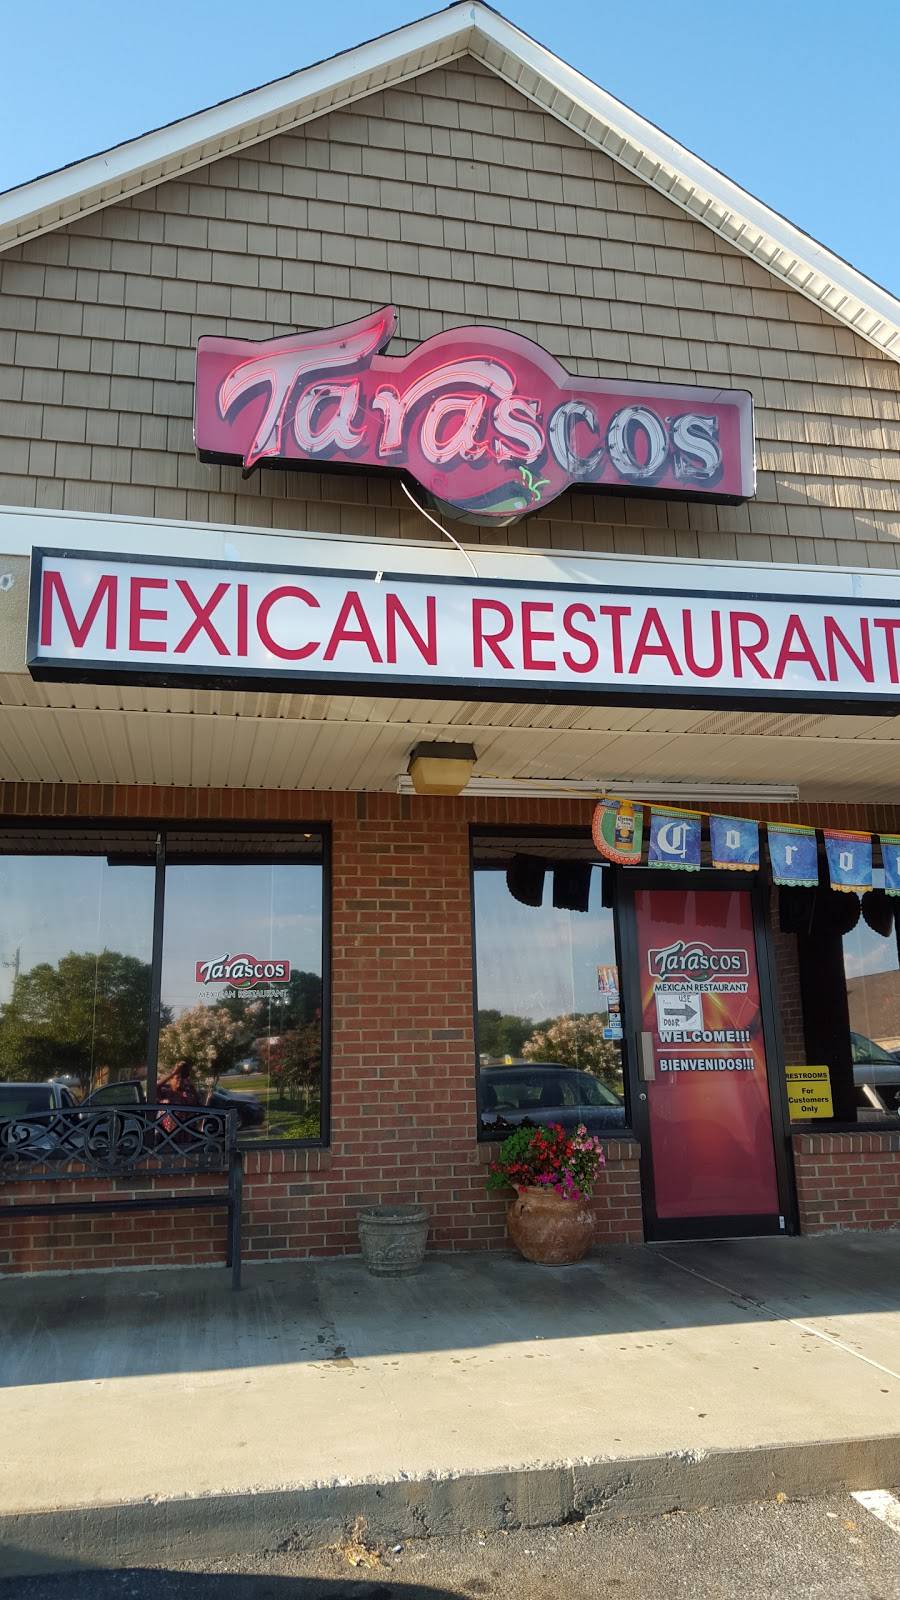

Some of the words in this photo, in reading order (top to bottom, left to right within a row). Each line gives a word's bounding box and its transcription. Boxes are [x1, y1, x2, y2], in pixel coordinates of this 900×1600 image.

[219, 320, 723, 478] Tarascos
[40, 570, 438, 666] MEXICAN
[472, 598, 900, 684] RESTAURANT
[655, 942, 741, 975] Tarascos
[200, 952, 285, 984] Tarascos
[655, 983, 694, 992] MEXICAN
[695, 983, 747, 992] RESTAURANT
[659, 1031, 750, 1044] WELCOME!!!
[660, 1058, 755, 1071] BIENVENIDOS!!!
[788, 1096, 830, 1104] Customers
[801, 1105, 819, 1114] Only
